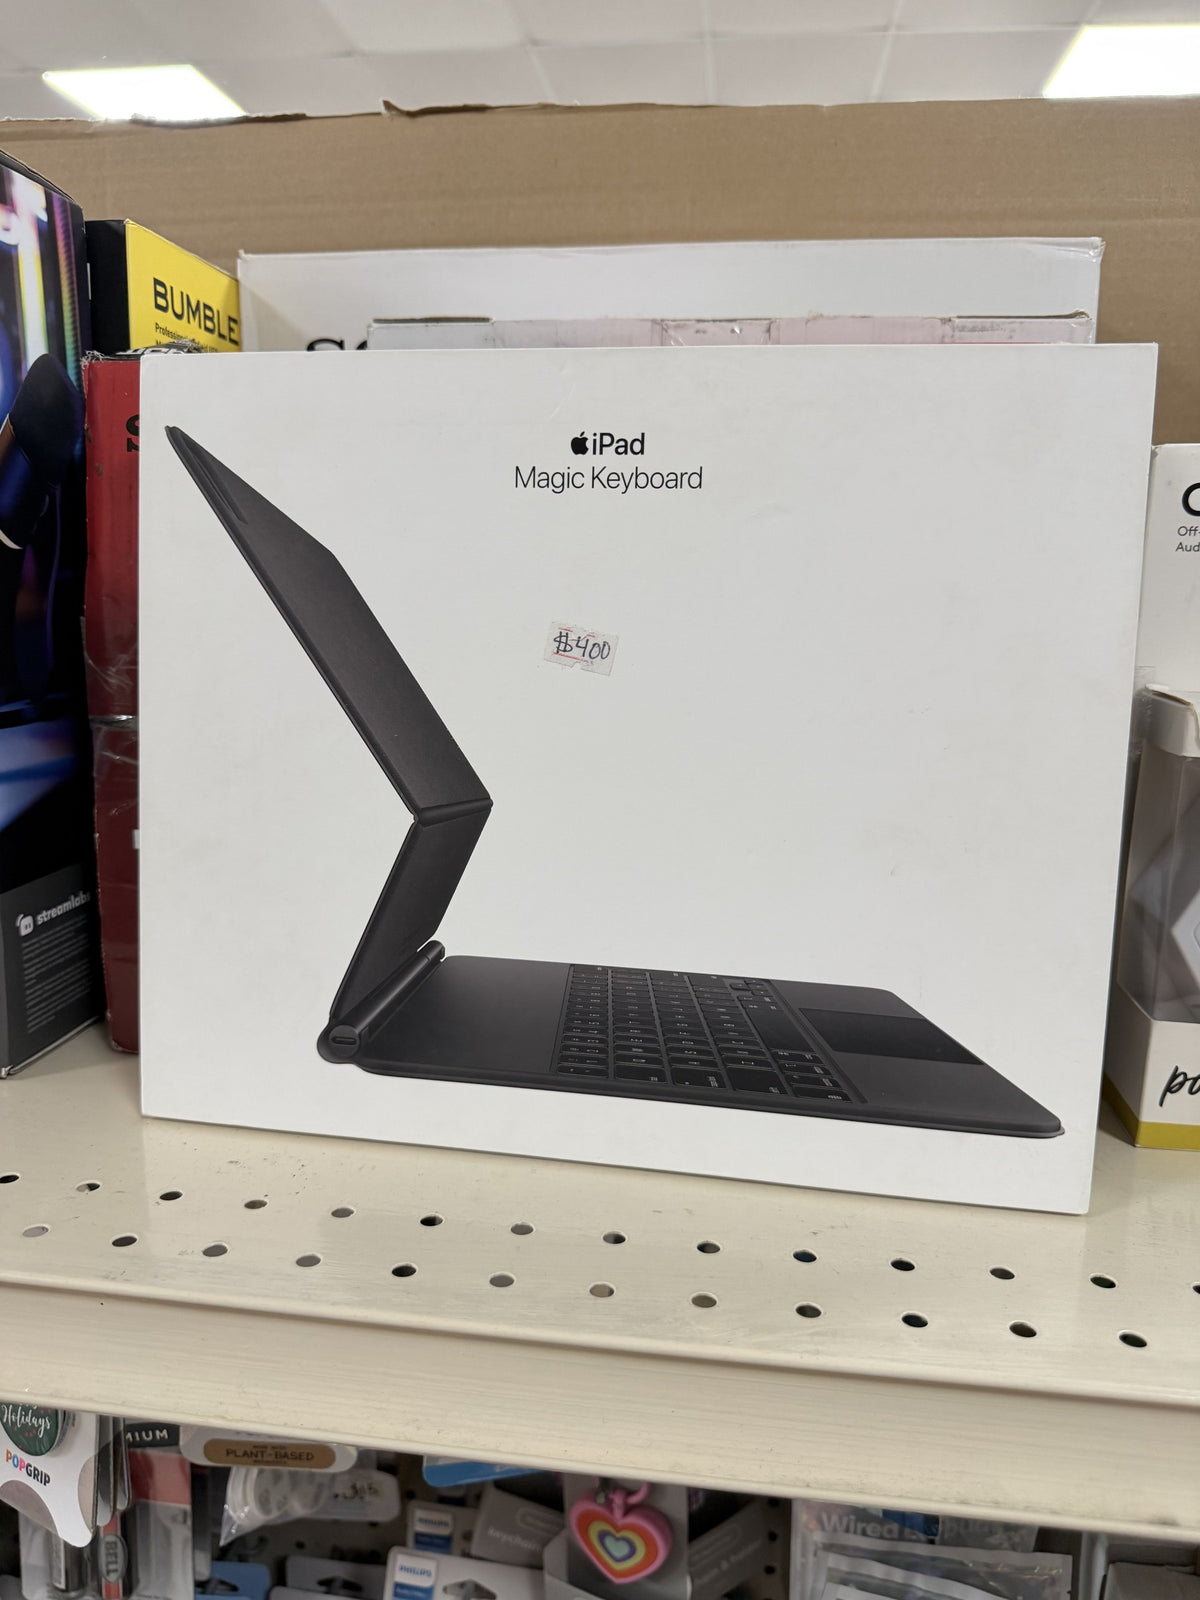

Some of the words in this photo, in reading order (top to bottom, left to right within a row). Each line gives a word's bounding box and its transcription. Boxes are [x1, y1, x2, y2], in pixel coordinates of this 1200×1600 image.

[152, 277, 239, 346] BUMBLE
[592, 432, 645, 456] iPad
[515, 466, 585, 494] Magic
[591, 466, 703, 494] Keyboard
[553, 631, 611, 660] $400
[1, 1404, 51, 1438] Holidays
[6, 1449, 51, 1486] POPGRIP
[225, 1448, 315, 1461] PLANT-BASED
[821, 1511, 898, 1539] Wired
[104, 1541, 119, 1576] BELL
